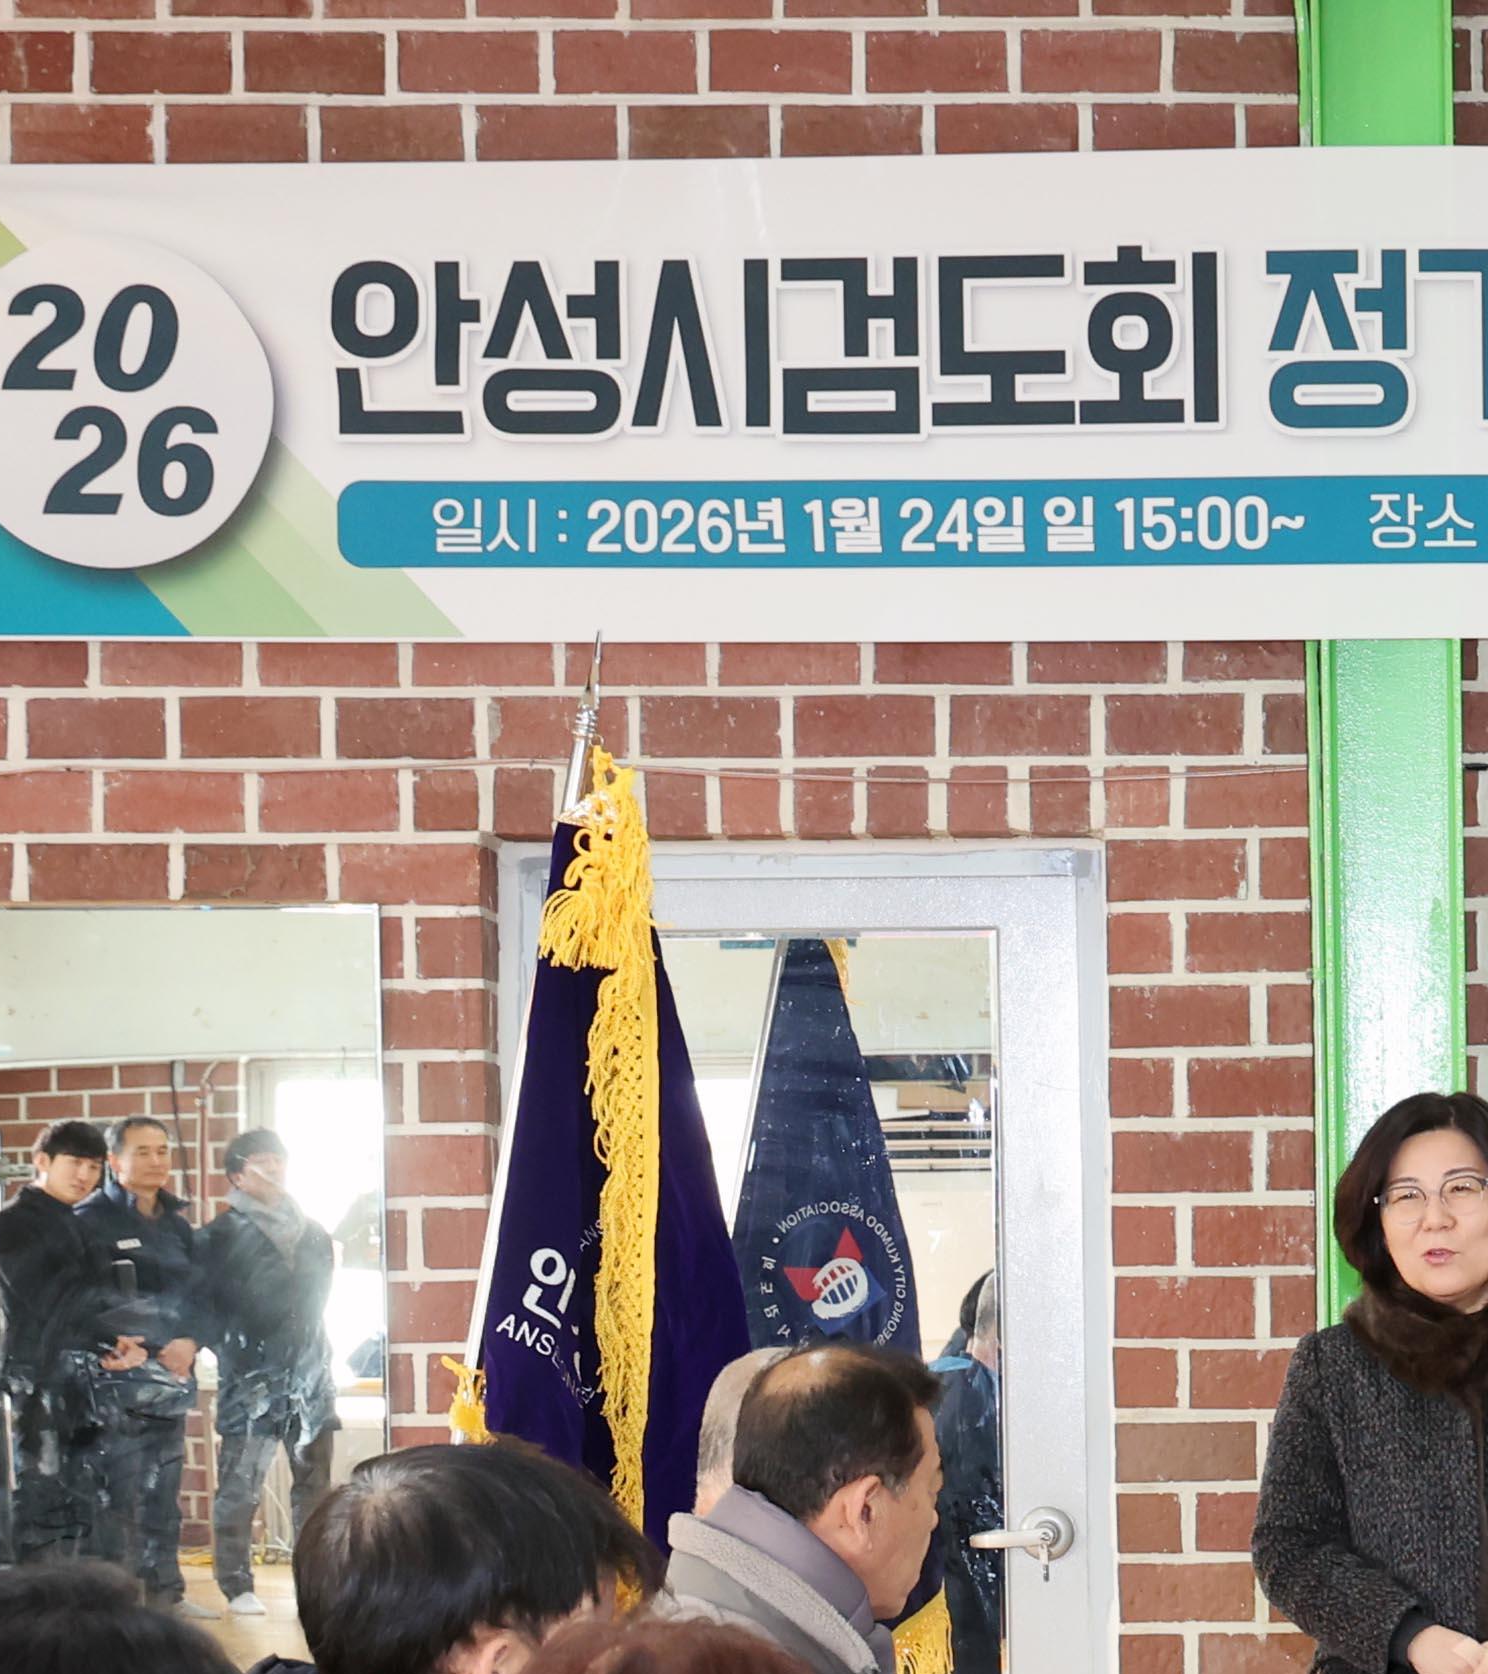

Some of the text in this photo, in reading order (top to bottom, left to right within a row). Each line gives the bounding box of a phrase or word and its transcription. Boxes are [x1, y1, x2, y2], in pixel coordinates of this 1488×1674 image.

[2, 284, 179, 392] 20
[330, 246, 1219, 435] 안성시검도회
[43, 405, 219, 517] 26
[432, 498, 537, 553] 일시
[586, 497, 786, 554] 2026년
[803, 496, 883, 554] 1월
[899, 496, 1026, 553] 24일
[1043, 495, 1095, 552] 일
[1115, 495, 1305, 551] 15:00~
[1369, 493, 1477, 549] 장소
[522, 1247, 578, 1336] 안
